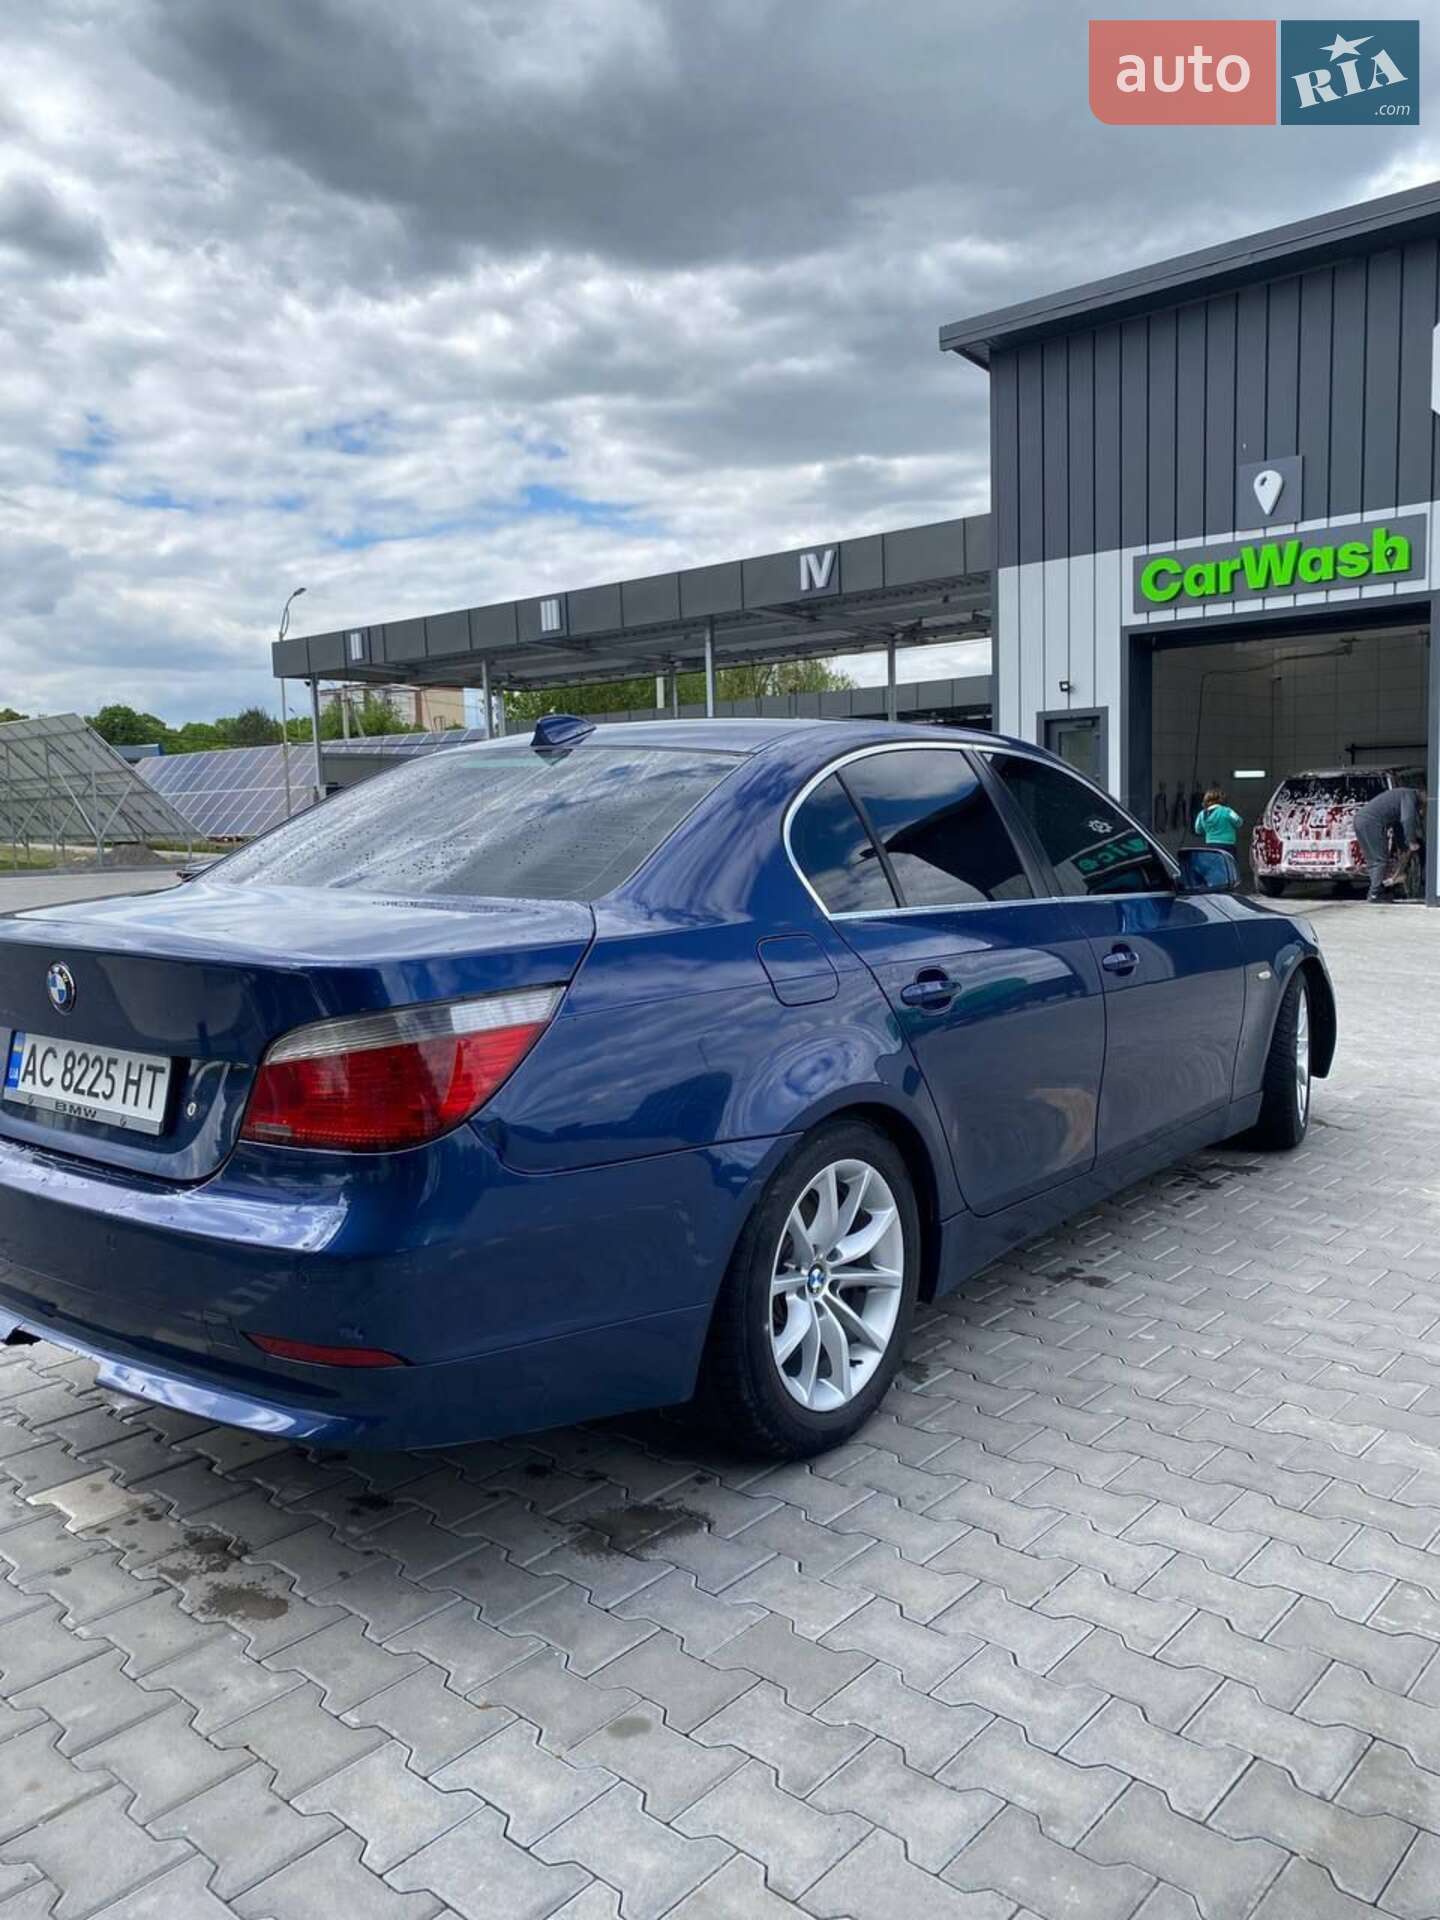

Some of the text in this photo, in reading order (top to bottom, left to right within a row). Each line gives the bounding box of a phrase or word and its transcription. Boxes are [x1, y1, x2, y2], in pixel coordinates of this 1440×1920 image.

[800, 550, 834, 590] IV
[1141, 527, 1411, 602] CarWash
[22, 1043, 165, 1109] AC 8225 HT
[55, 1101, 97, 1119] BMW
